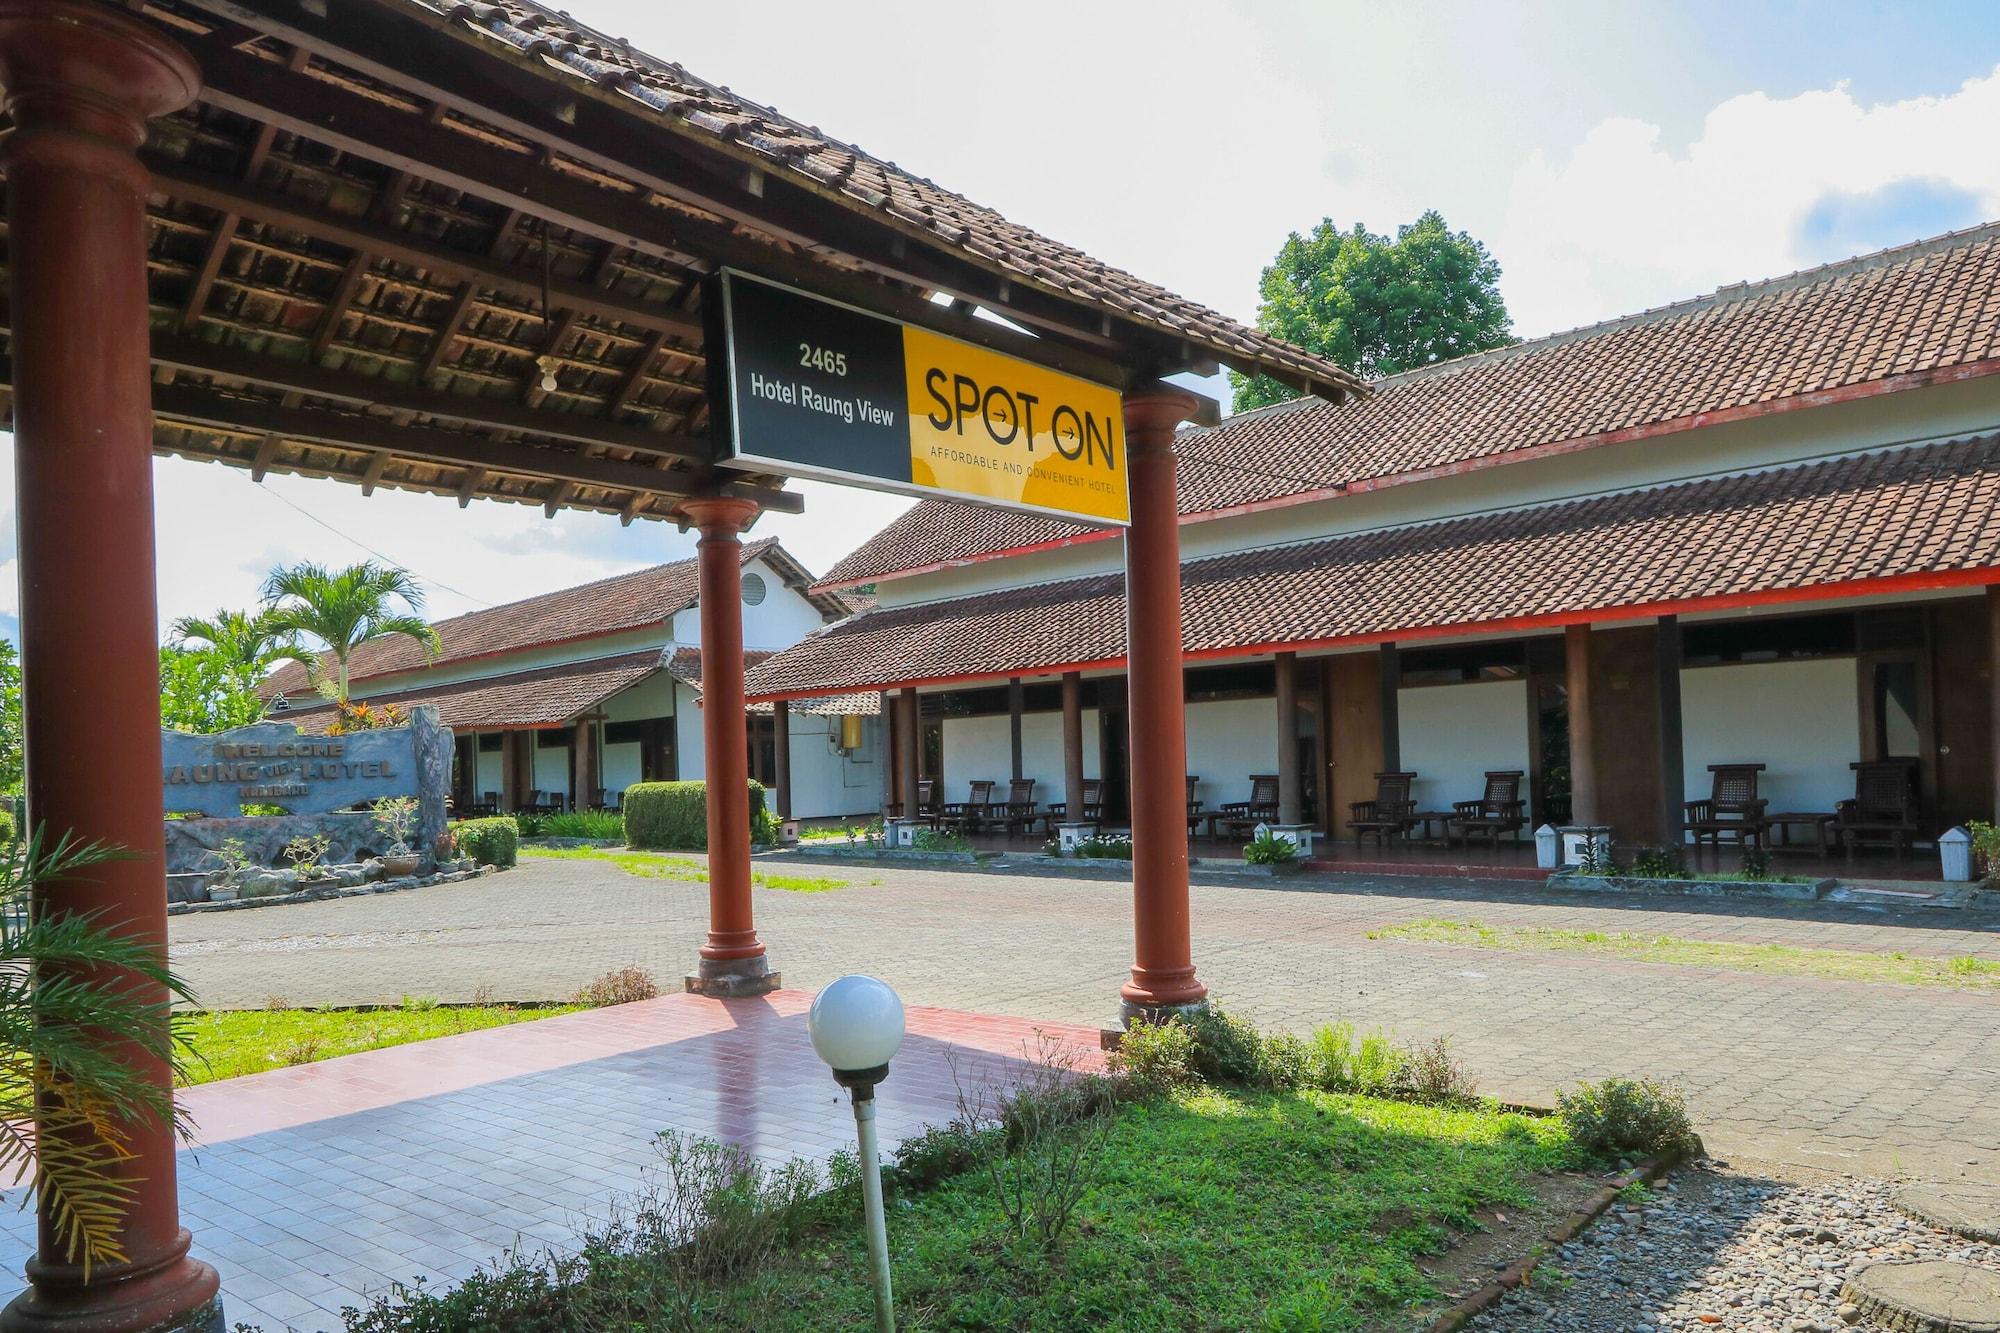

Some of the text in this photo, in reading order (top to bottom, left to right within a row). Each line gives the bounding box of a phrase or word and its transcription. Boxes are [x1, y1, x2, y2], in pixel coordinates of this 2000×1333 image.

[799, 343, 847, 376] 2465
[751, 372, 894, 427] Hotel Raung View
[926, 367, 1115, 471] SPOT ON
[930, 445, 1117, 495] AFFORDABLE AND CONVENIENT HOTEL
[214, 742, 345, 758] WELCOME
[162, 761, 258, 785] AUNG
